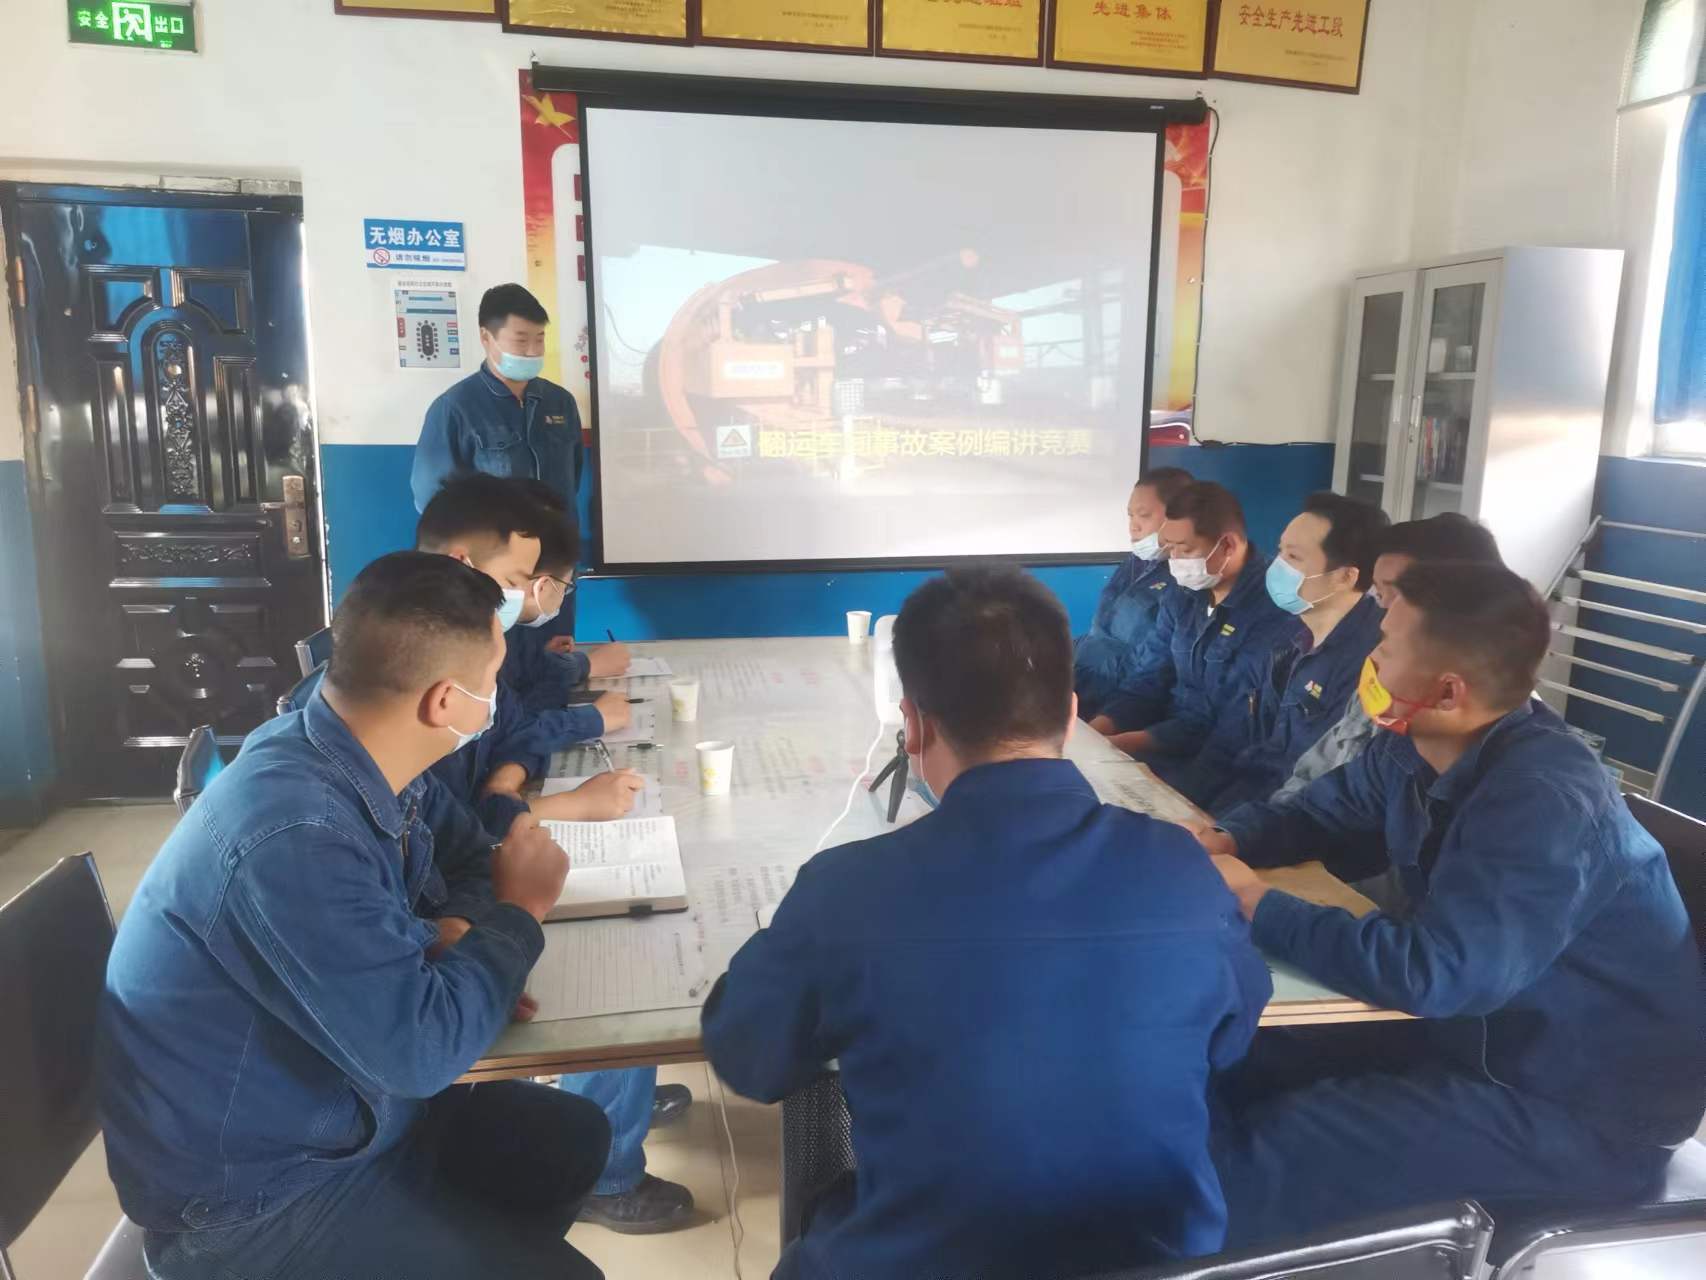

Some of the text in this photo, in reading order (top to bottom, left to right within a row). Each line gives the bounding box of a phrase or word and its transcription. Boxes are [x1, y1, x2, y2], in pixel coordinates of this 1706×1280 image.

[77, 10, 184, 34] 安全 出口
[1092, 2, 1172, 20] 先进集体
[1239, 4, 1343, 37] 安全生产先进工段
[369, 227, 460, 247] 无烟办公室
